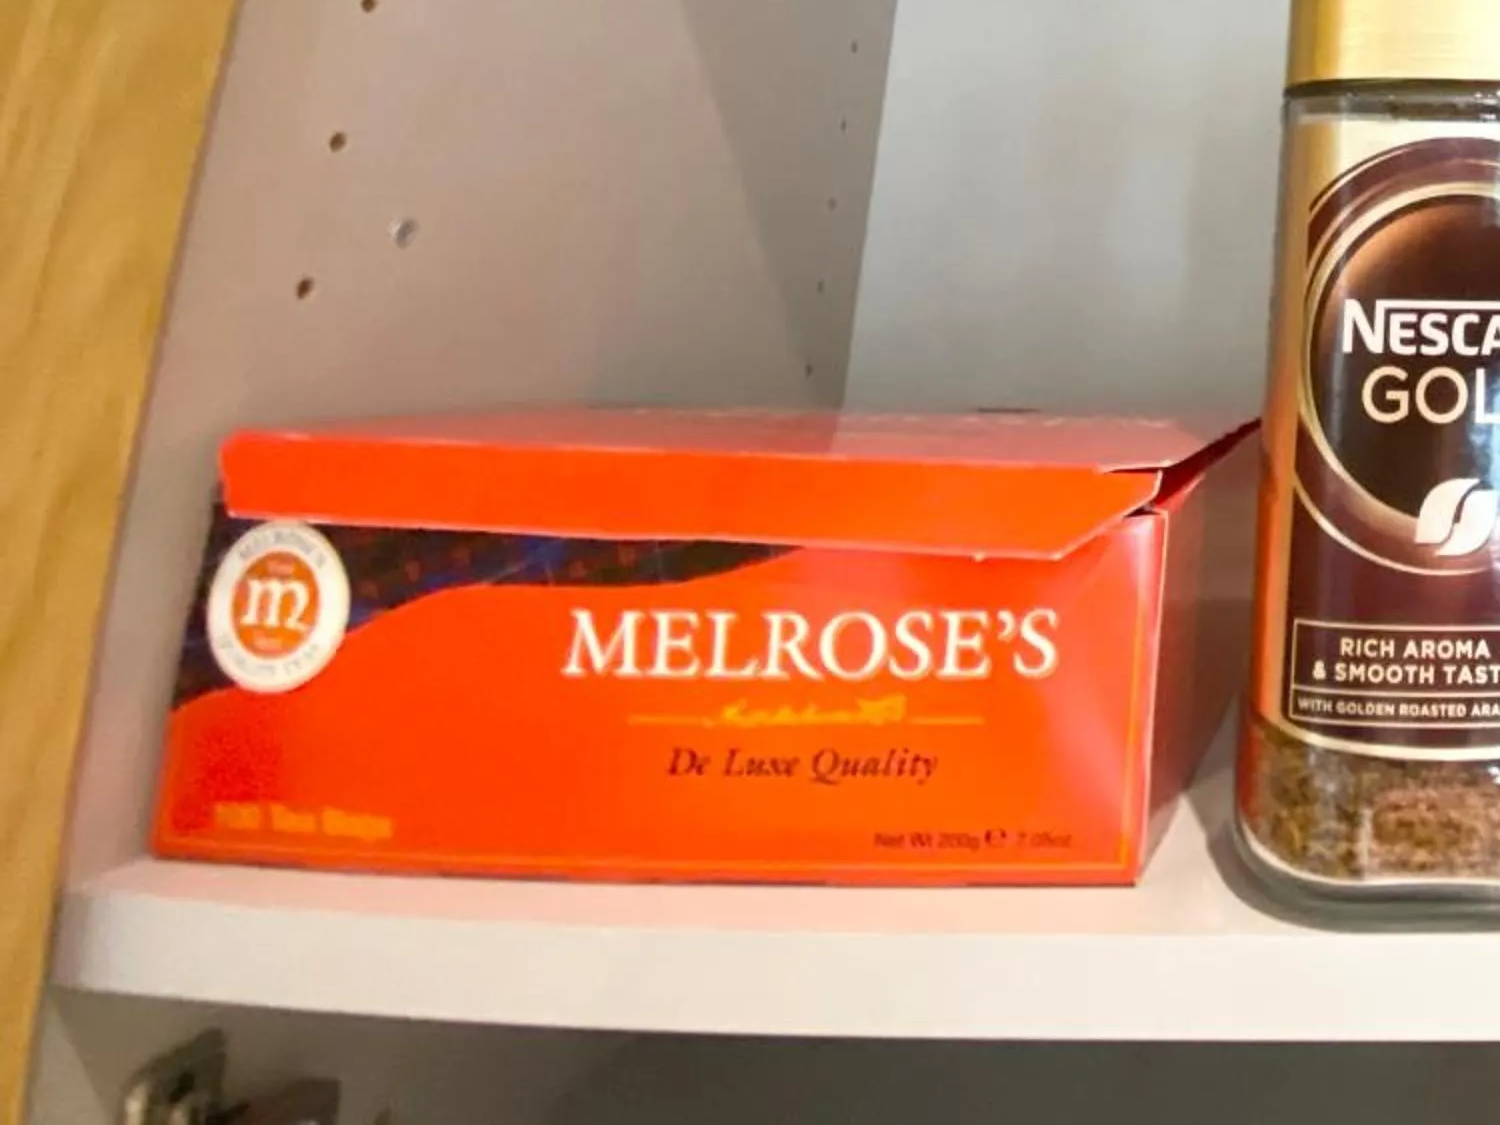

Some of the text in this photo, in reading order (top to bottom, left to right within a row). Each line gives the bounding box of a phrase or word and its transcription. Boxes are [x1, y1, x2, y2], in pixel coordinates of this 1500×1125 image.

[562, 608, 1059, 682] MELROSE'S
[1339, 636, 1492, 660] RICH AROMA
[1312, 660, 1327, 681] &
[1334, 662, 1436, 685] SMOOTH
[1297, 697, 1334, 713] WITH
[1335, 701, 1396, 717] GOLDEN
[1398, 703, 1467, 718] ROASTED
[666, 746, 939, 785] De Luxe Quality
